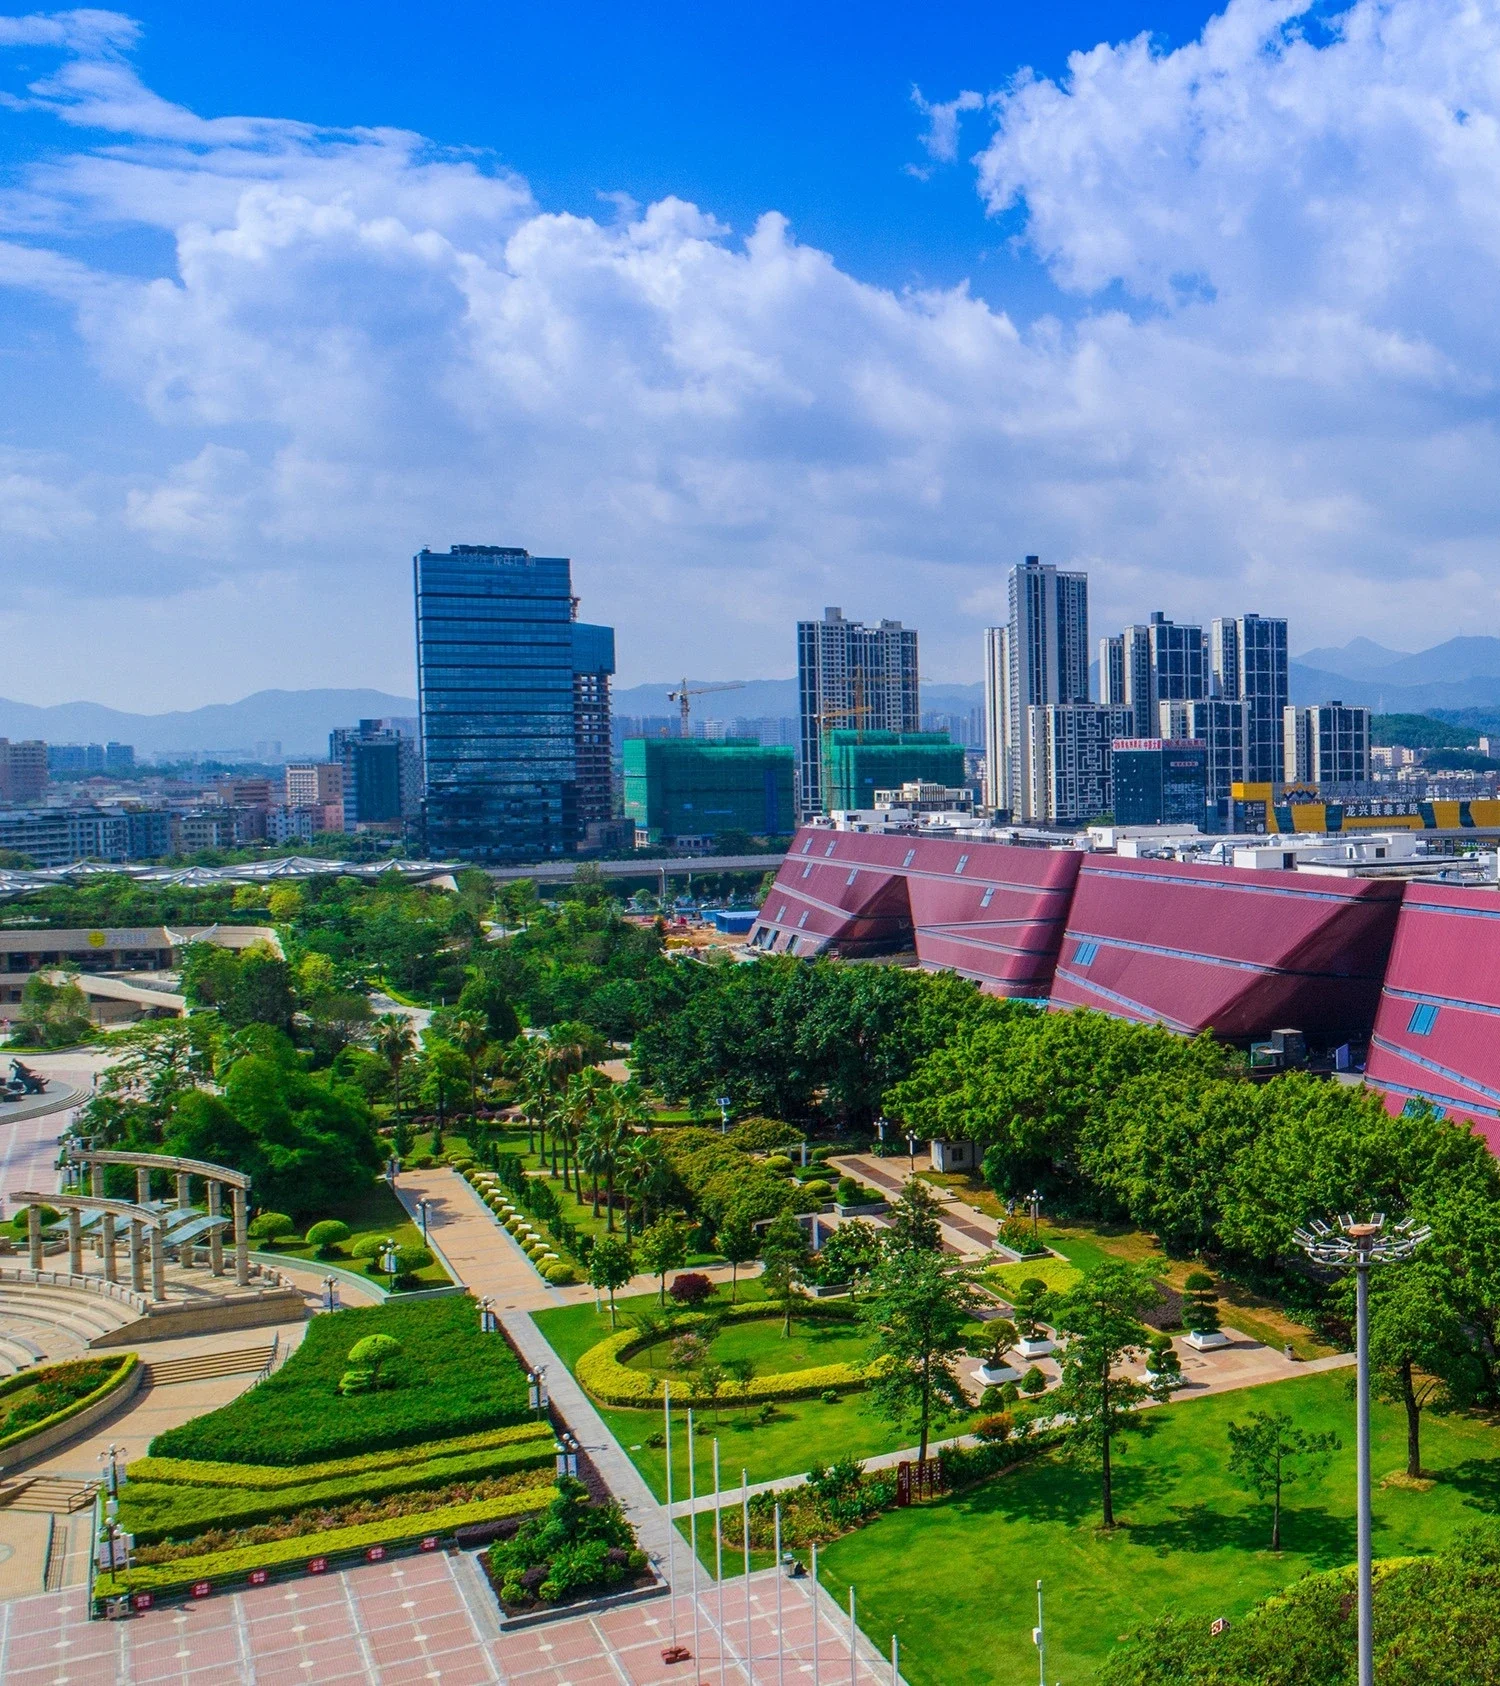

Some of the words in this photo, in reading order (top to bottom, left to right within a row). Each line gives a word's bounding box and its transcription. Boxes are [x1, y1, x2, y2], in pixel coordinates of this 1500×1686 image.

[1346, 803, 1418, 817] 龙兴联泰家居
